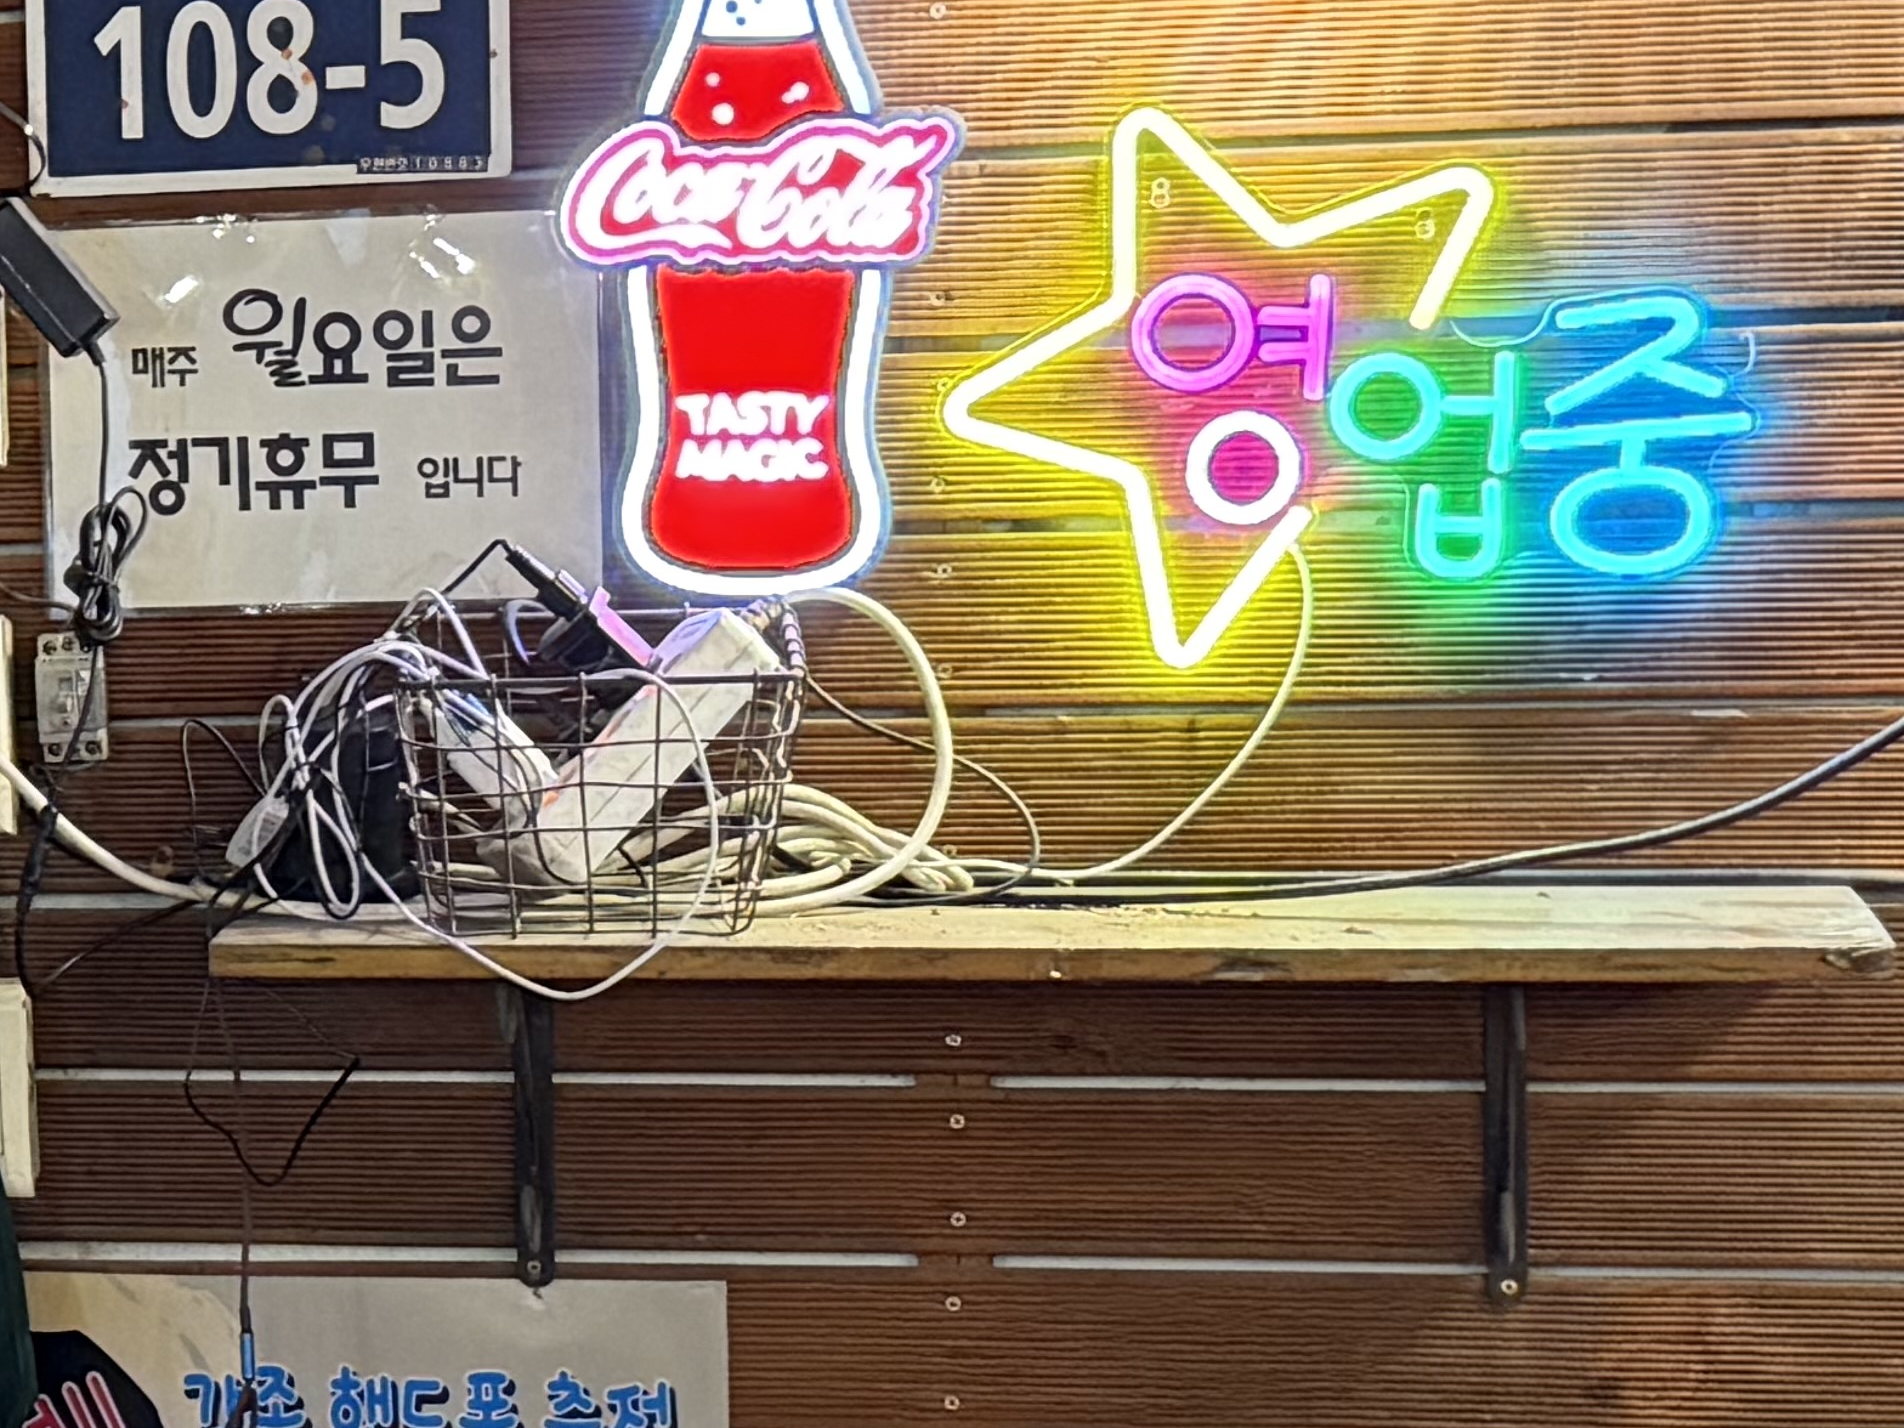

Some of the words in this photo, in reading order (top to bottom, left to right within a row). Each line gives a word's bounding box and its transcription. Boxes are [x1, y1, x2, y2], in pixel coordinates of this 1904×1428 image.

[130, 346, 199, 387] 매주
[222, 286, 504, 389] 월요일은
[674, 391, 831, 436] TASTY
[1130, 270, 1757, 582] 영업중
[128, 430, 380, 516] 정기휴무
[416, 454, 522, 500] 입니다
[674, 438, 828, 482] MAGIC
